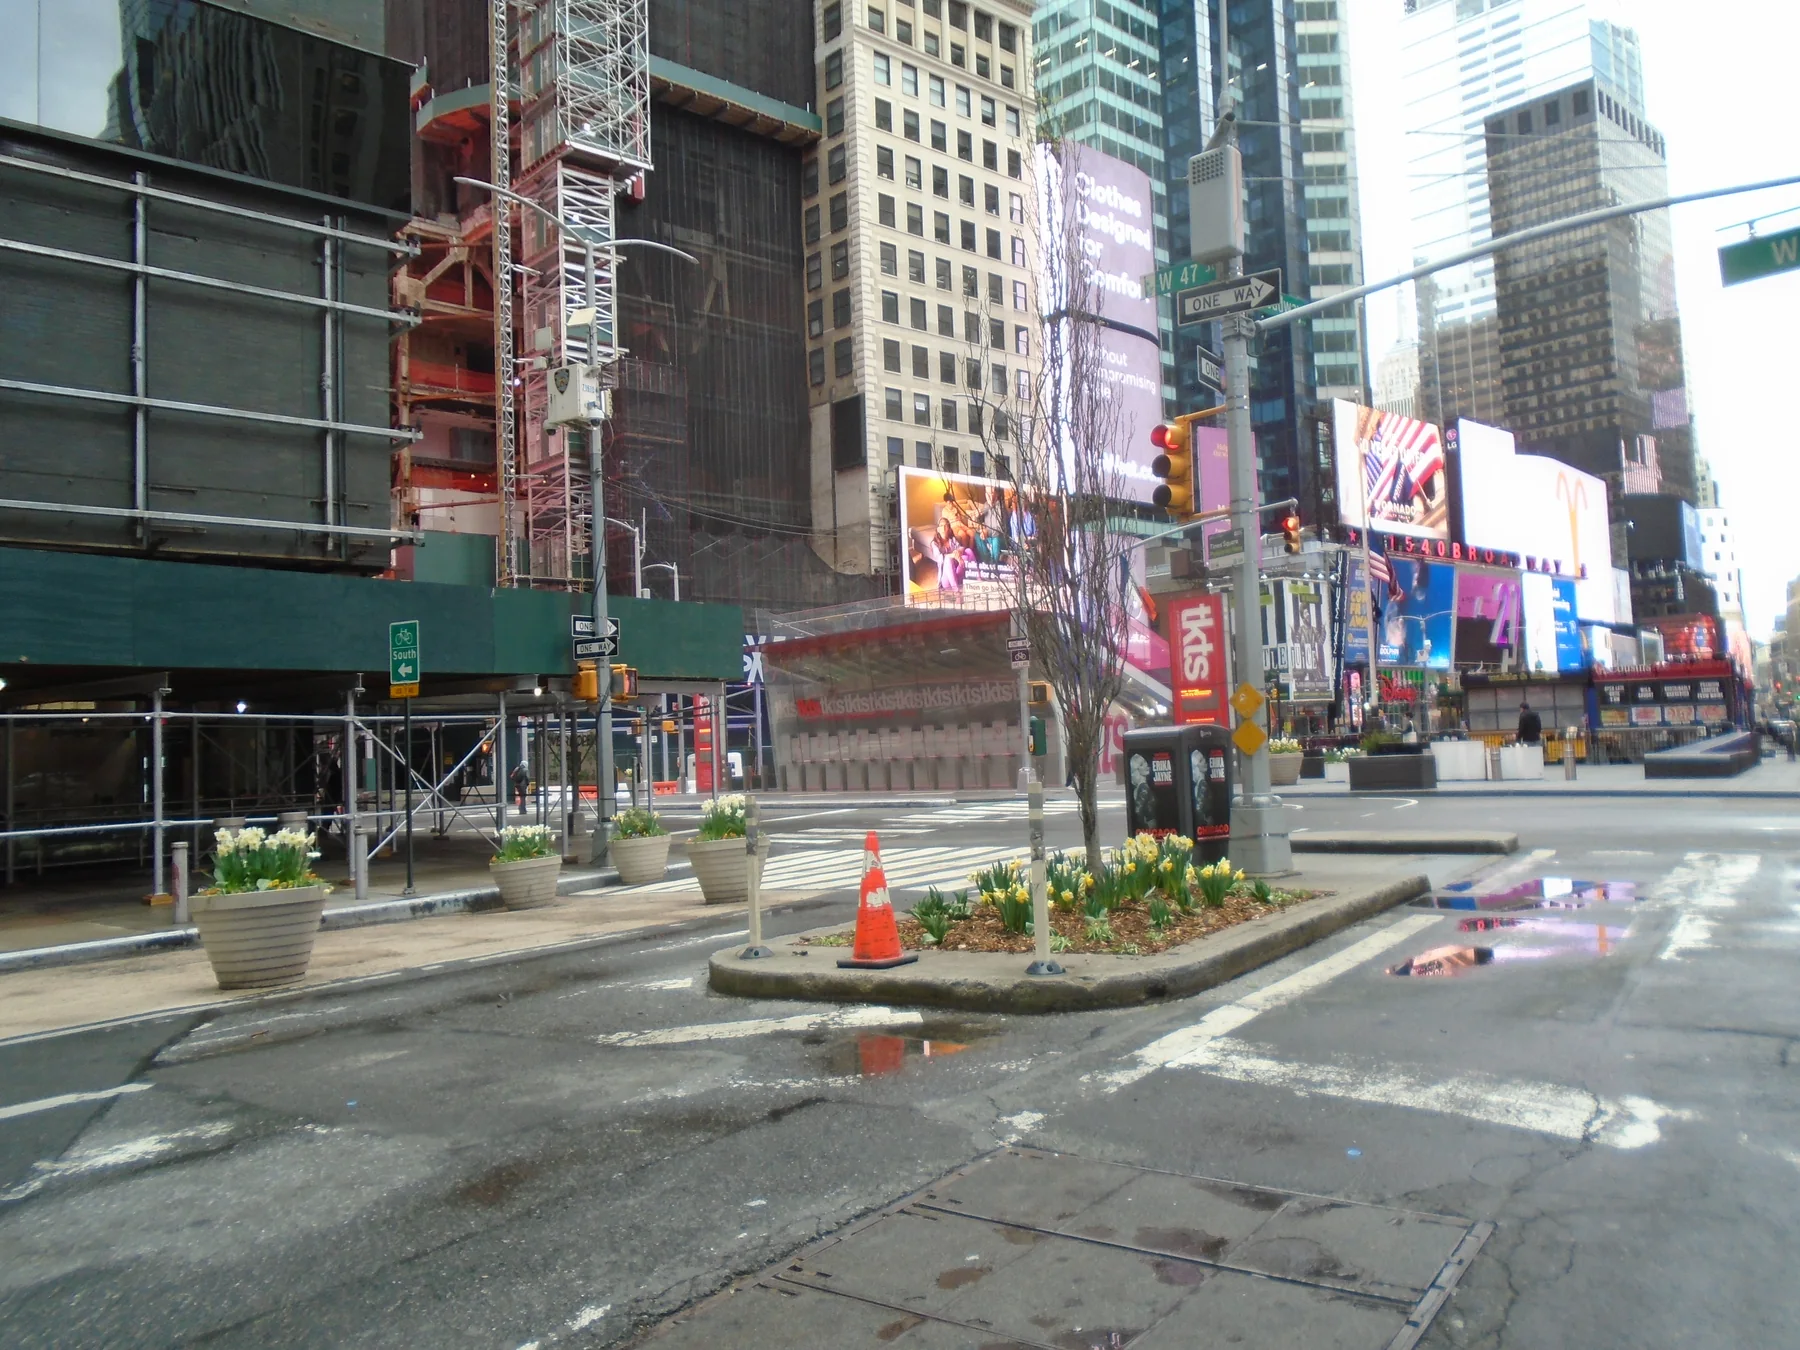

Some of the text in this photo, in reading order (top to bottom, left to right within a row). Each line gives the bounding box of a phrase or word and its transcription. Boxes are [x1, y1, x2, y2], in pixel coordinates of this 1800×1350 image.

[1075, 172, 1141, 218] Clothes
[1076, 200, 1151, 252] Designed
[1771, 236, 1798, 265] W
[1159, 271, 1172, 291] W
[1180, 264, 1198, 285] 47
[1192, 285, 1264, 312] ONE WAY
[1205, 362, 1220, 382] ONE
[1447, 441, 1457, 449] LG
[580, 622, 592, 630] ONE
[580, 642, 611, 652] ONE WAY
[1180, 603, 1213, 681] tkts
[392, 649, 417, 660] South
[1152, 760, 1171, 772] ERIKA
[1210, 757, 1225, 768] ERIKA
[1153, 771, 1172, 782] JAYNE
[1210, 768, 1225, 779] JAYNE
